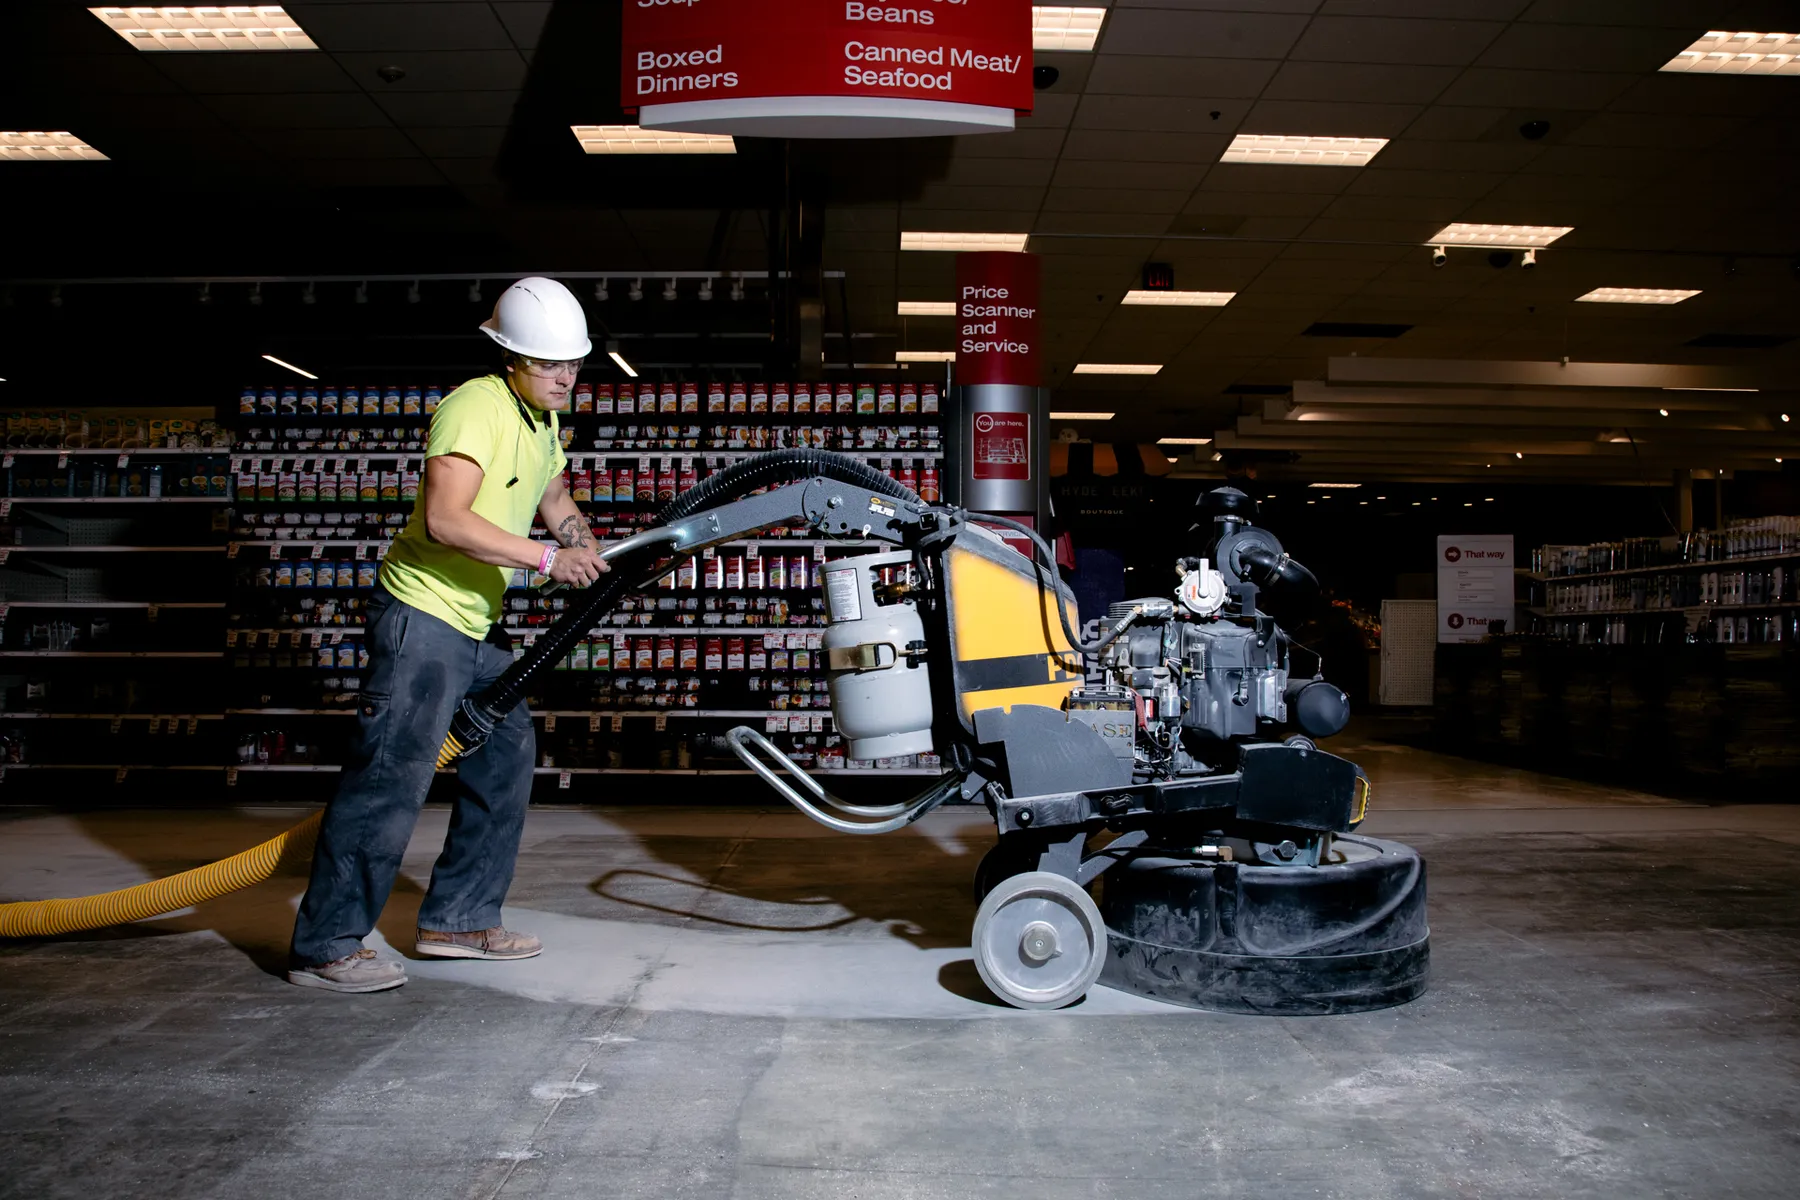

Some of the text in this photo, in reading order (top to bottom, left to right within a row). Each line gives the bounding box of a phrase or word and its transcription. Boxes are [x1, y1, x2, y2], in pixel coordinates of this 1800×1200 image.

[845, 1, 935, 26] Beans
[637, 43, 723, 71] Boxed
[844, 40, 1022, 74] Canned Meat/
[636, 71, 739, 95] Dinners
[844, 65, 952, 91] Seafood
[962, 285, 1009, 300] Price
[962, 303, 1036, 319] Scanner
[962, 320, 997, 336] and
[961, 338, 1029, 354] Service
[1464, 550, 1505, 560] That way
[1466, 617, 1487, 626] That
